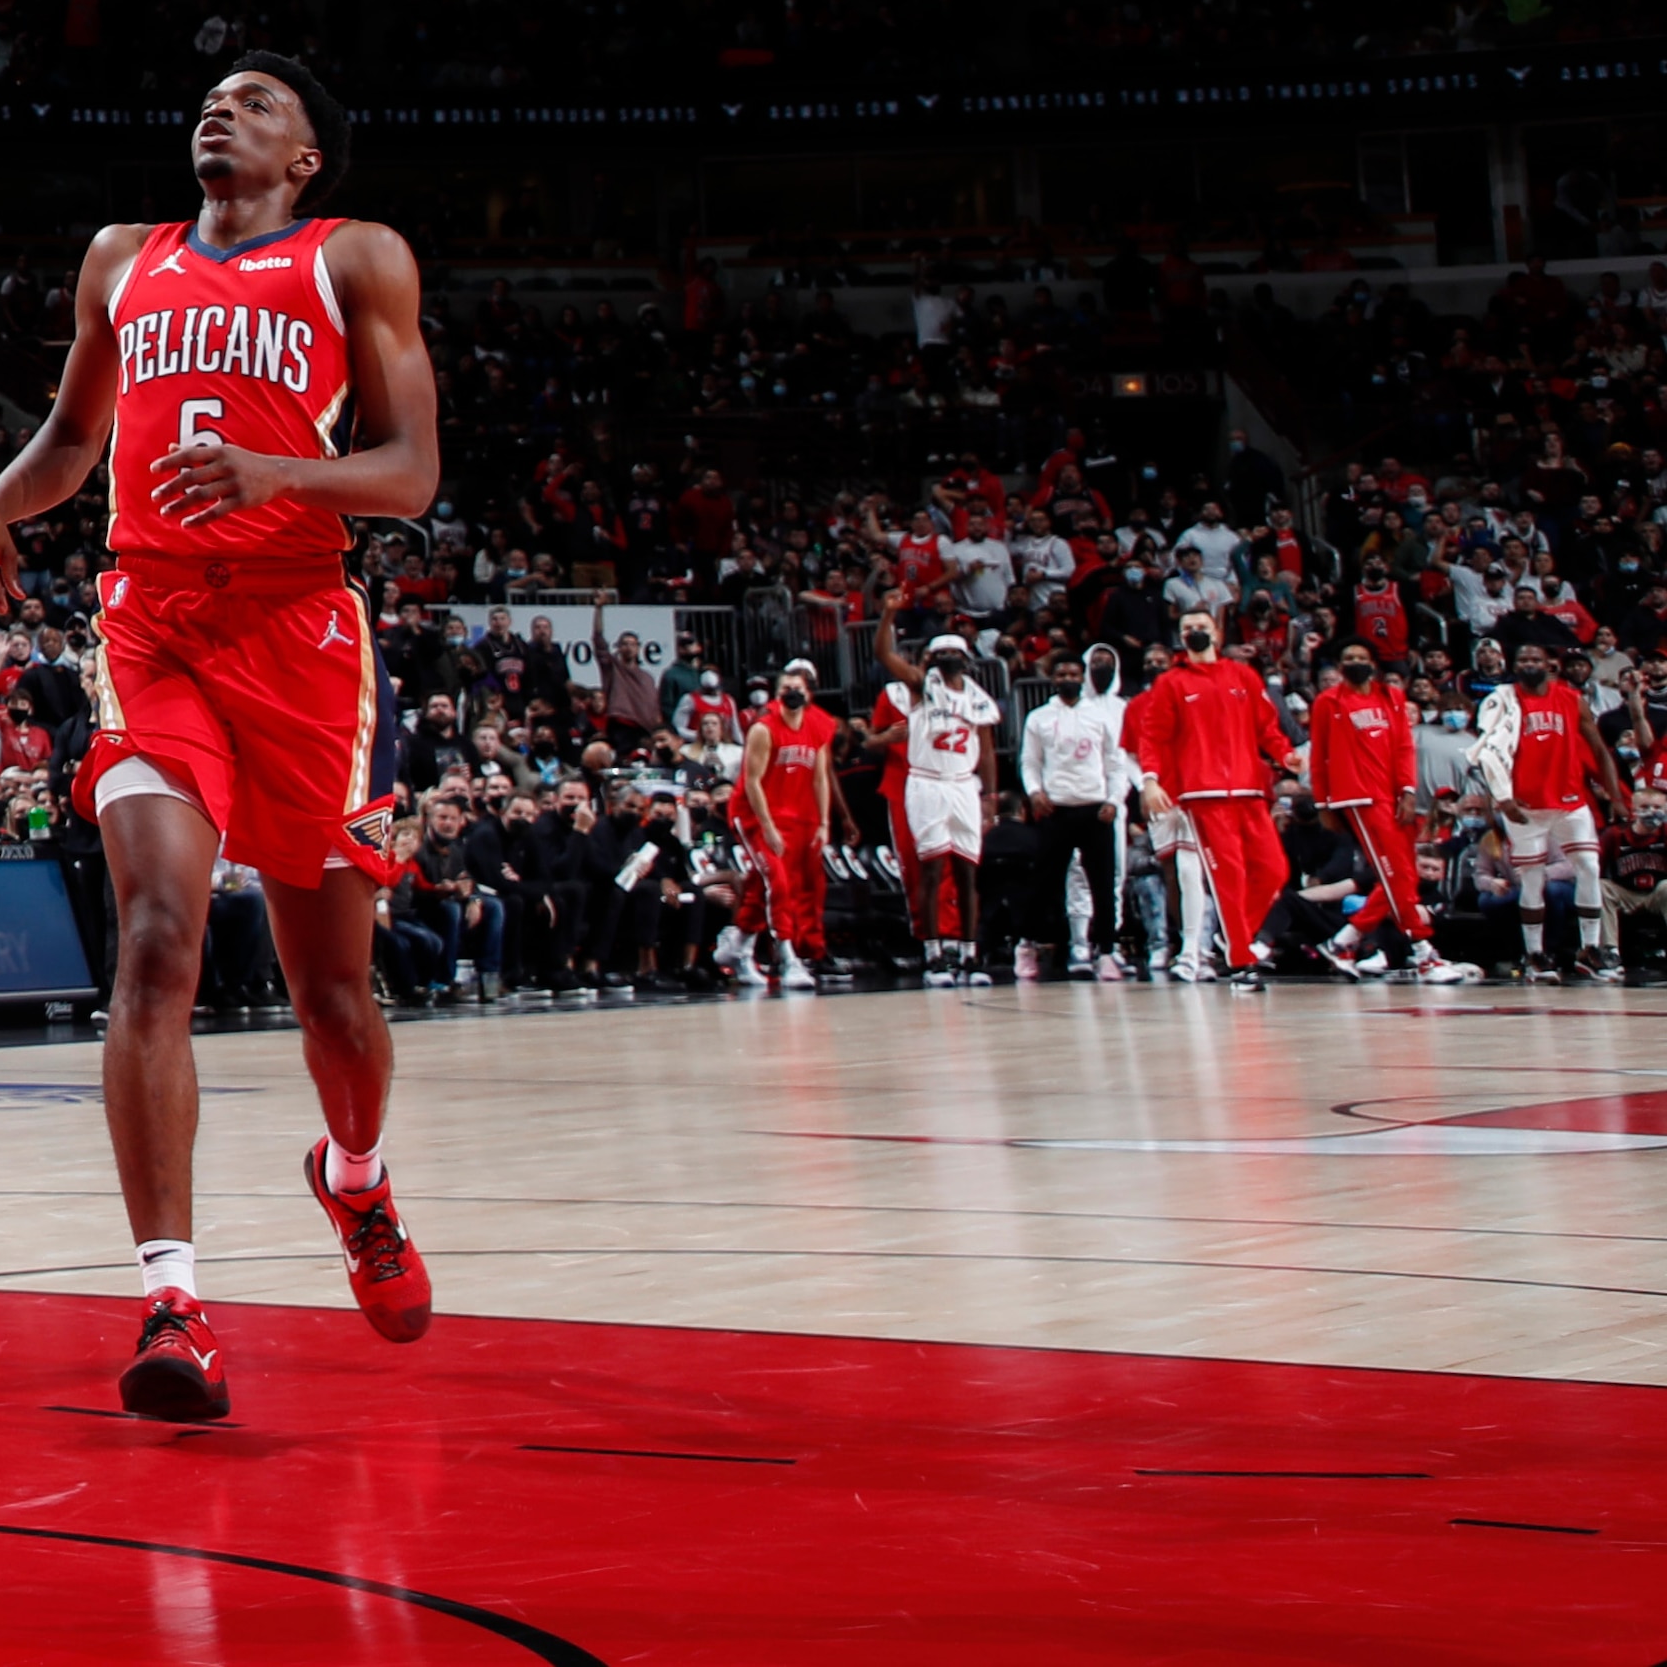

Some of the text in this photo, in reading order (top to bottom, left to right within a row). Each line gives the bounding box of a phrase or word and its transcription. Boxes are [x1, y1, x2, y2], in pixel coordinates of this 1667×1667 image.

[238, 256, 292, 272] ibotta
[118, 305, 314, 395] PELICANS
[1373, 617, 1387, 637] 2
[934, 728, 968, 754] 22
